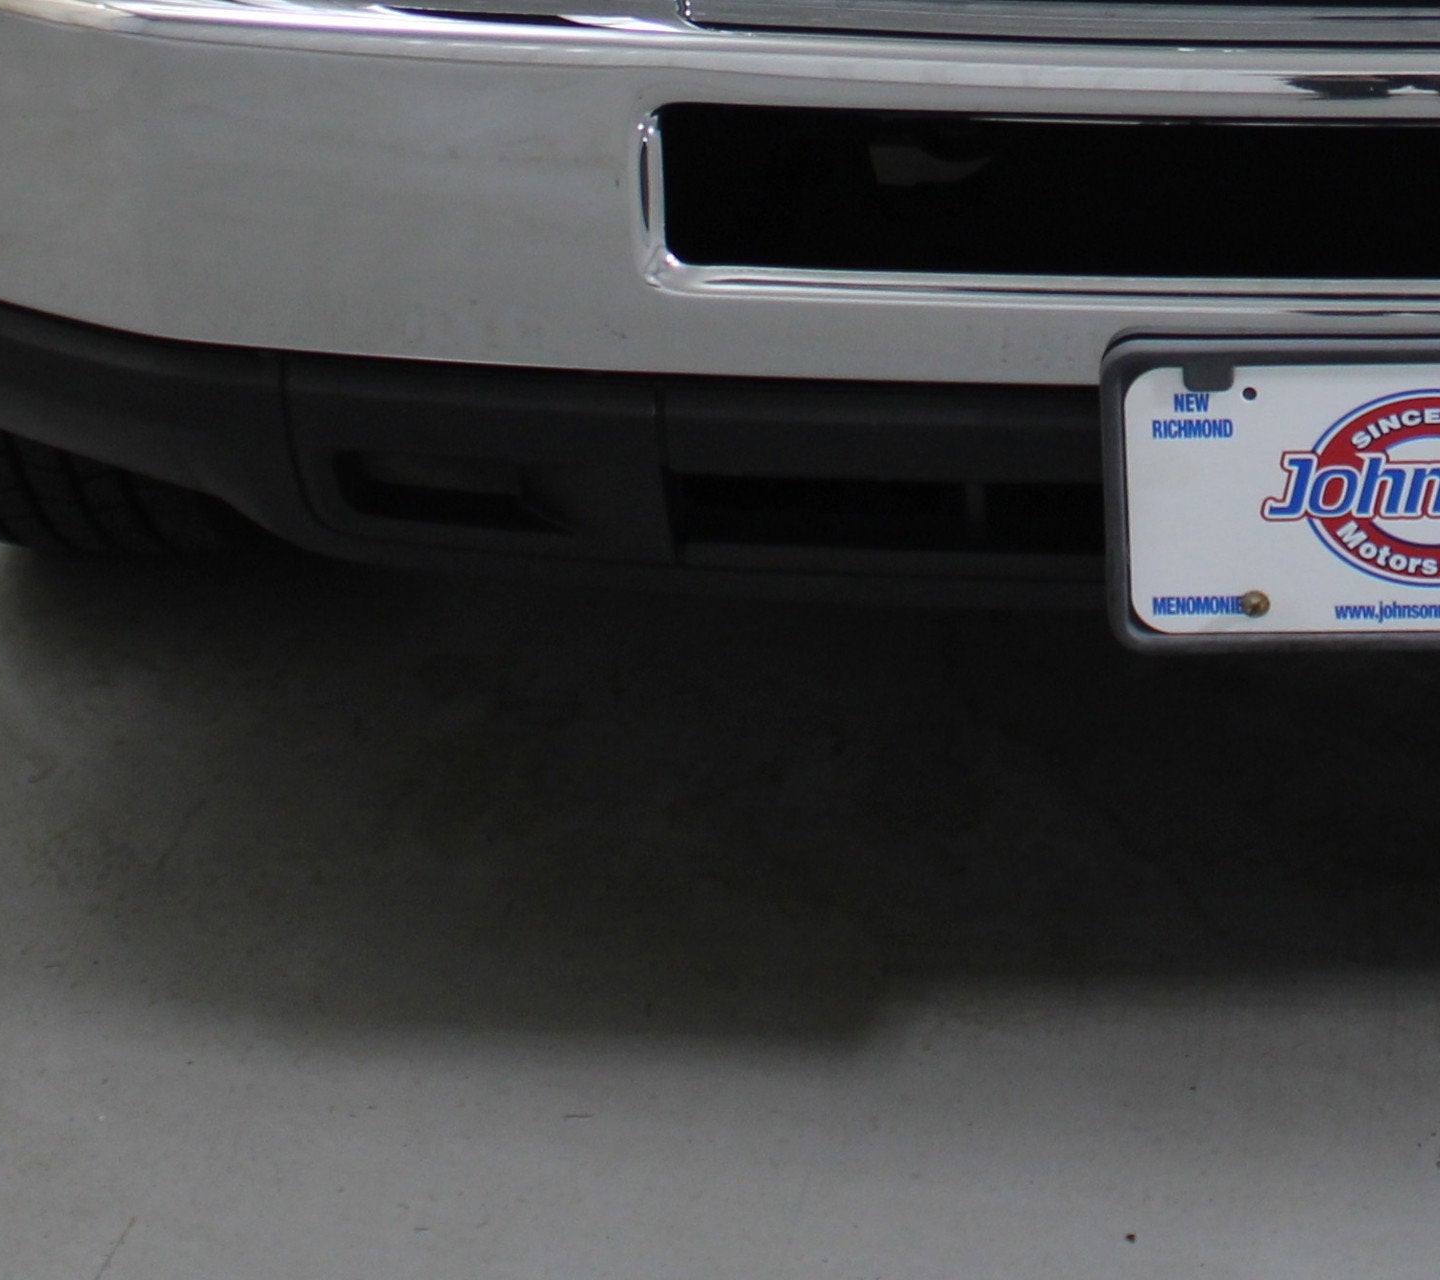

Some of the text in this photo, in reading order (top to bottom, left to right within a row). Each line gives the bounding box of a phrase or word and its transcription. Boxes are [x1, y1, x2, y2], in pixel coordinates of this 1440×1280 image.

[1173, 393, 1210, 413] NEW
[1152, 418, 1234, 439] RICHMOND
[1335, 520, 1439, 576] Motors
